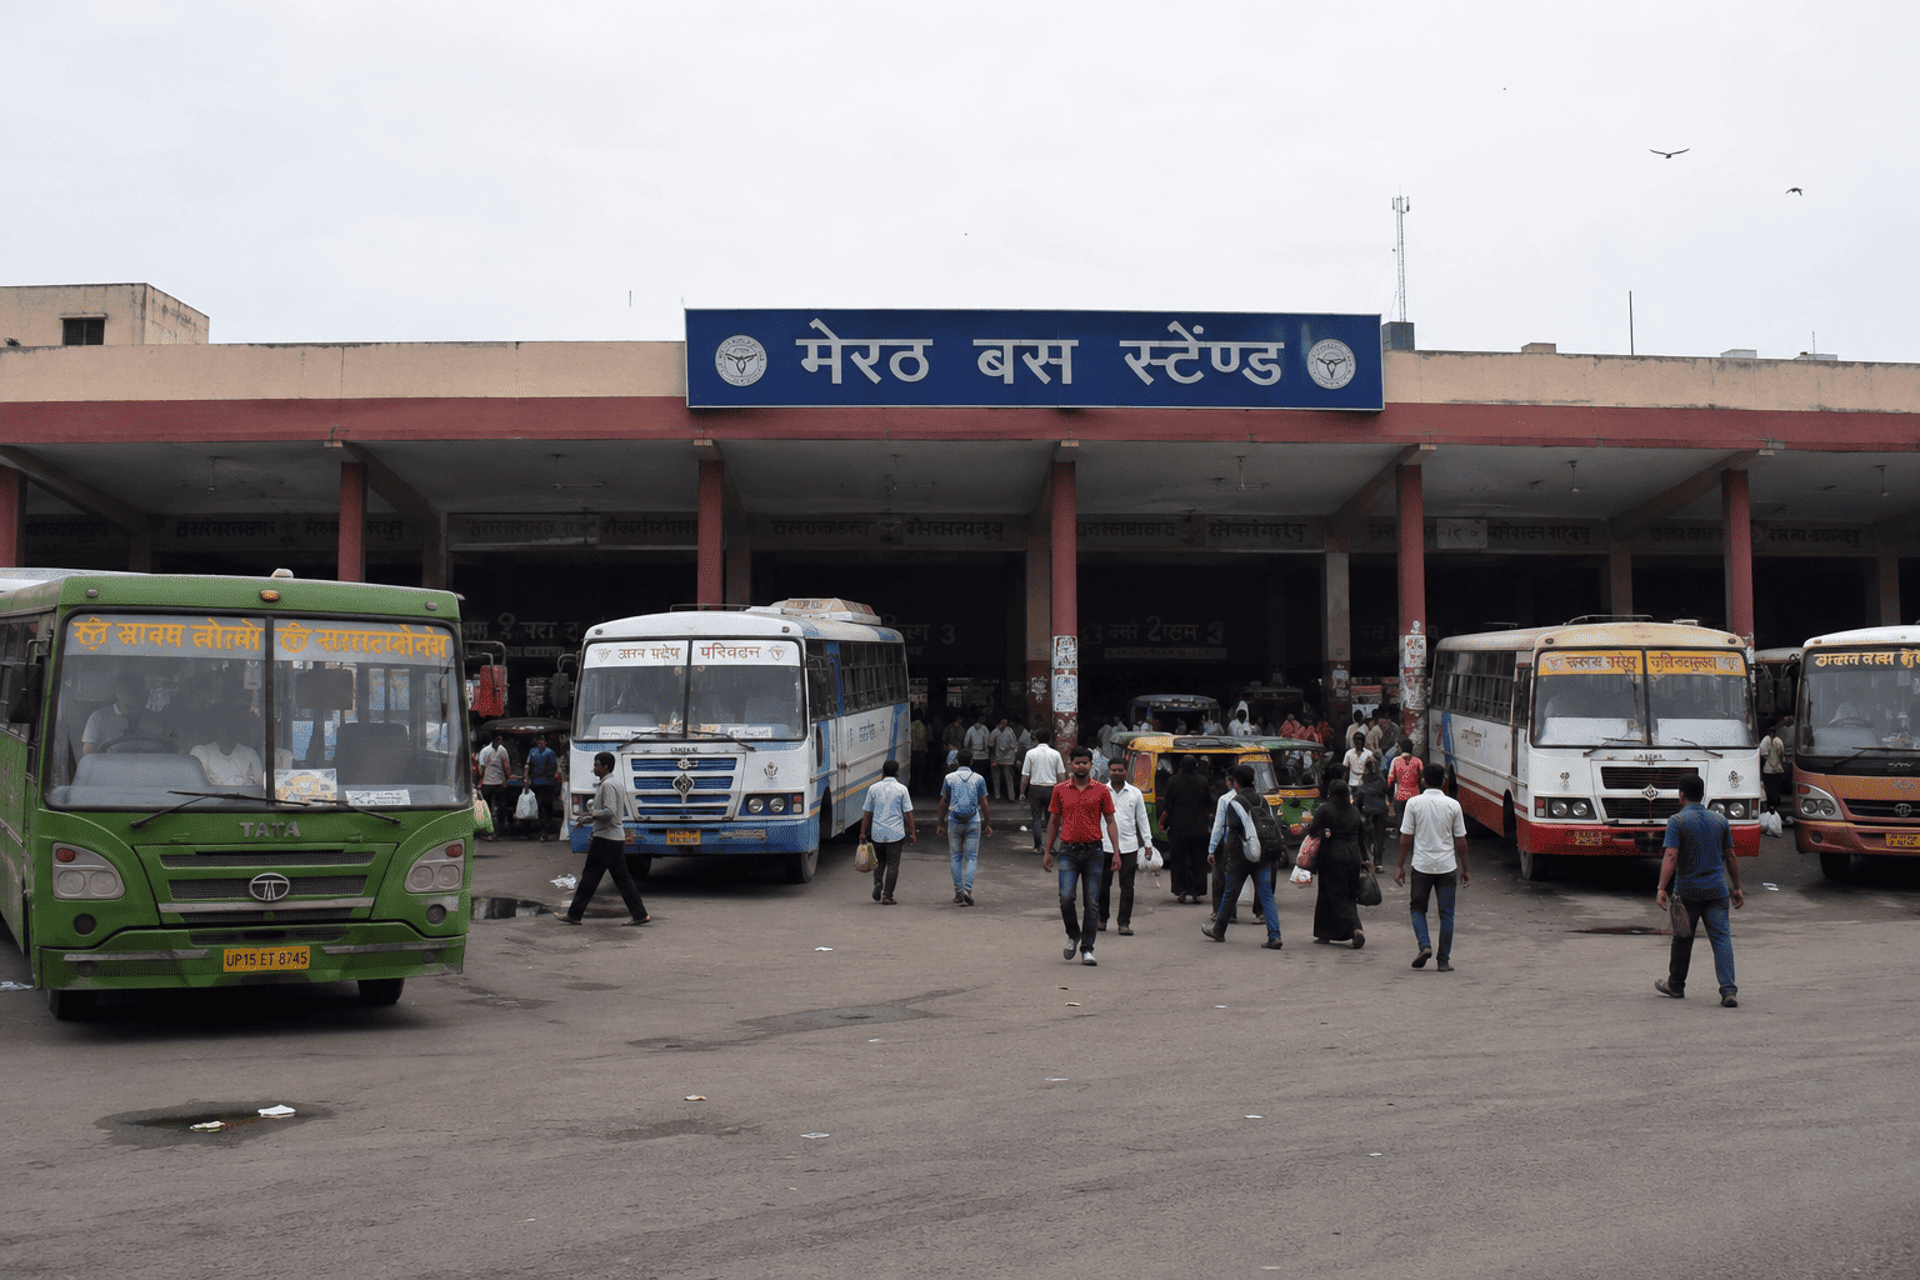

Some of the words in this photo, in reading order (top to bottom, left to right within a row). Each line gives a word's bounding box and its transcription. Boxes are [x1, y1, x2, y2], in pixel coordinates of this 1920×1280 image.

[795, 318, 933, 384] मेरठ
[972, 339, 1079, 384] बस
[239, 821, 301, 838] TATA
[226, 953, 257, 967] UP15
[259, 953, 275, 966] ET
[278, 951, 308, 965] 8745
